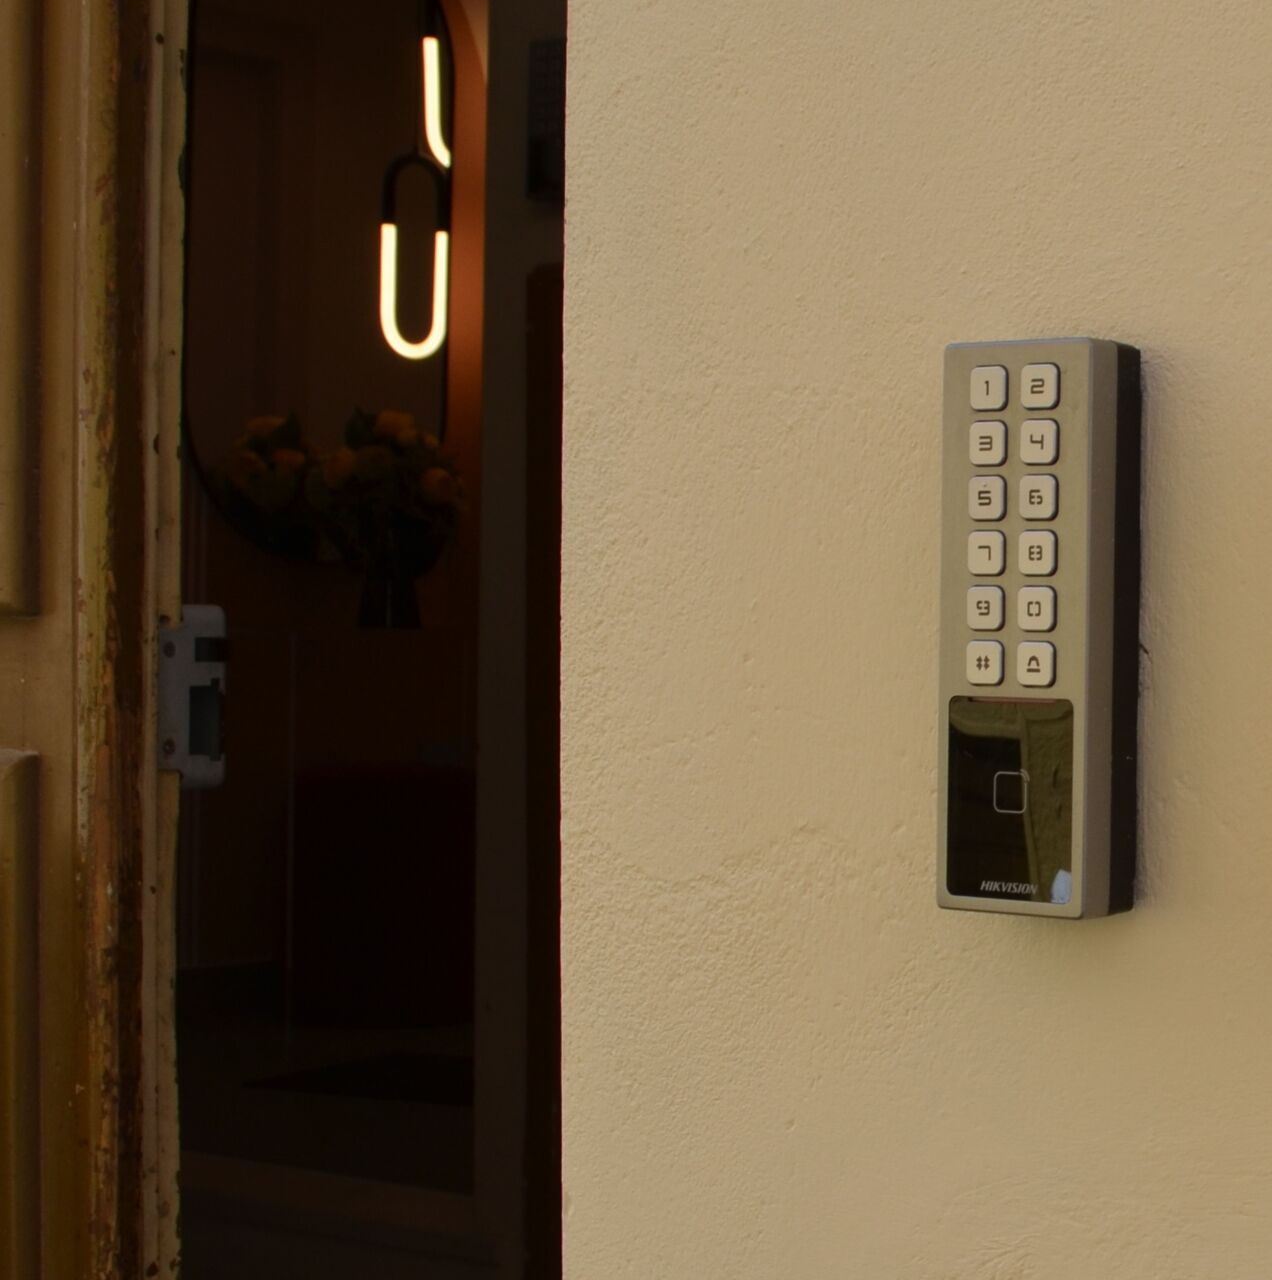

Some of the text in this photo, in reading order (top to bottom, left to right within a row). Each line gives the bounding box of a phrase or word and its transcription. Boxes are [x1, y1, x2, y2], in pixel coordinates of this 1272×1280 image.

[1030, 378, 1045, 395] 2
[978, 434, 1045, 452] 3 4
[977, 488, 1044, 507] 5 6
[977, 544, 1043, 562] 7 8
[975, 600, 1042, 617] 9 0
[979, 879, 1038, 895] HIKVISION
